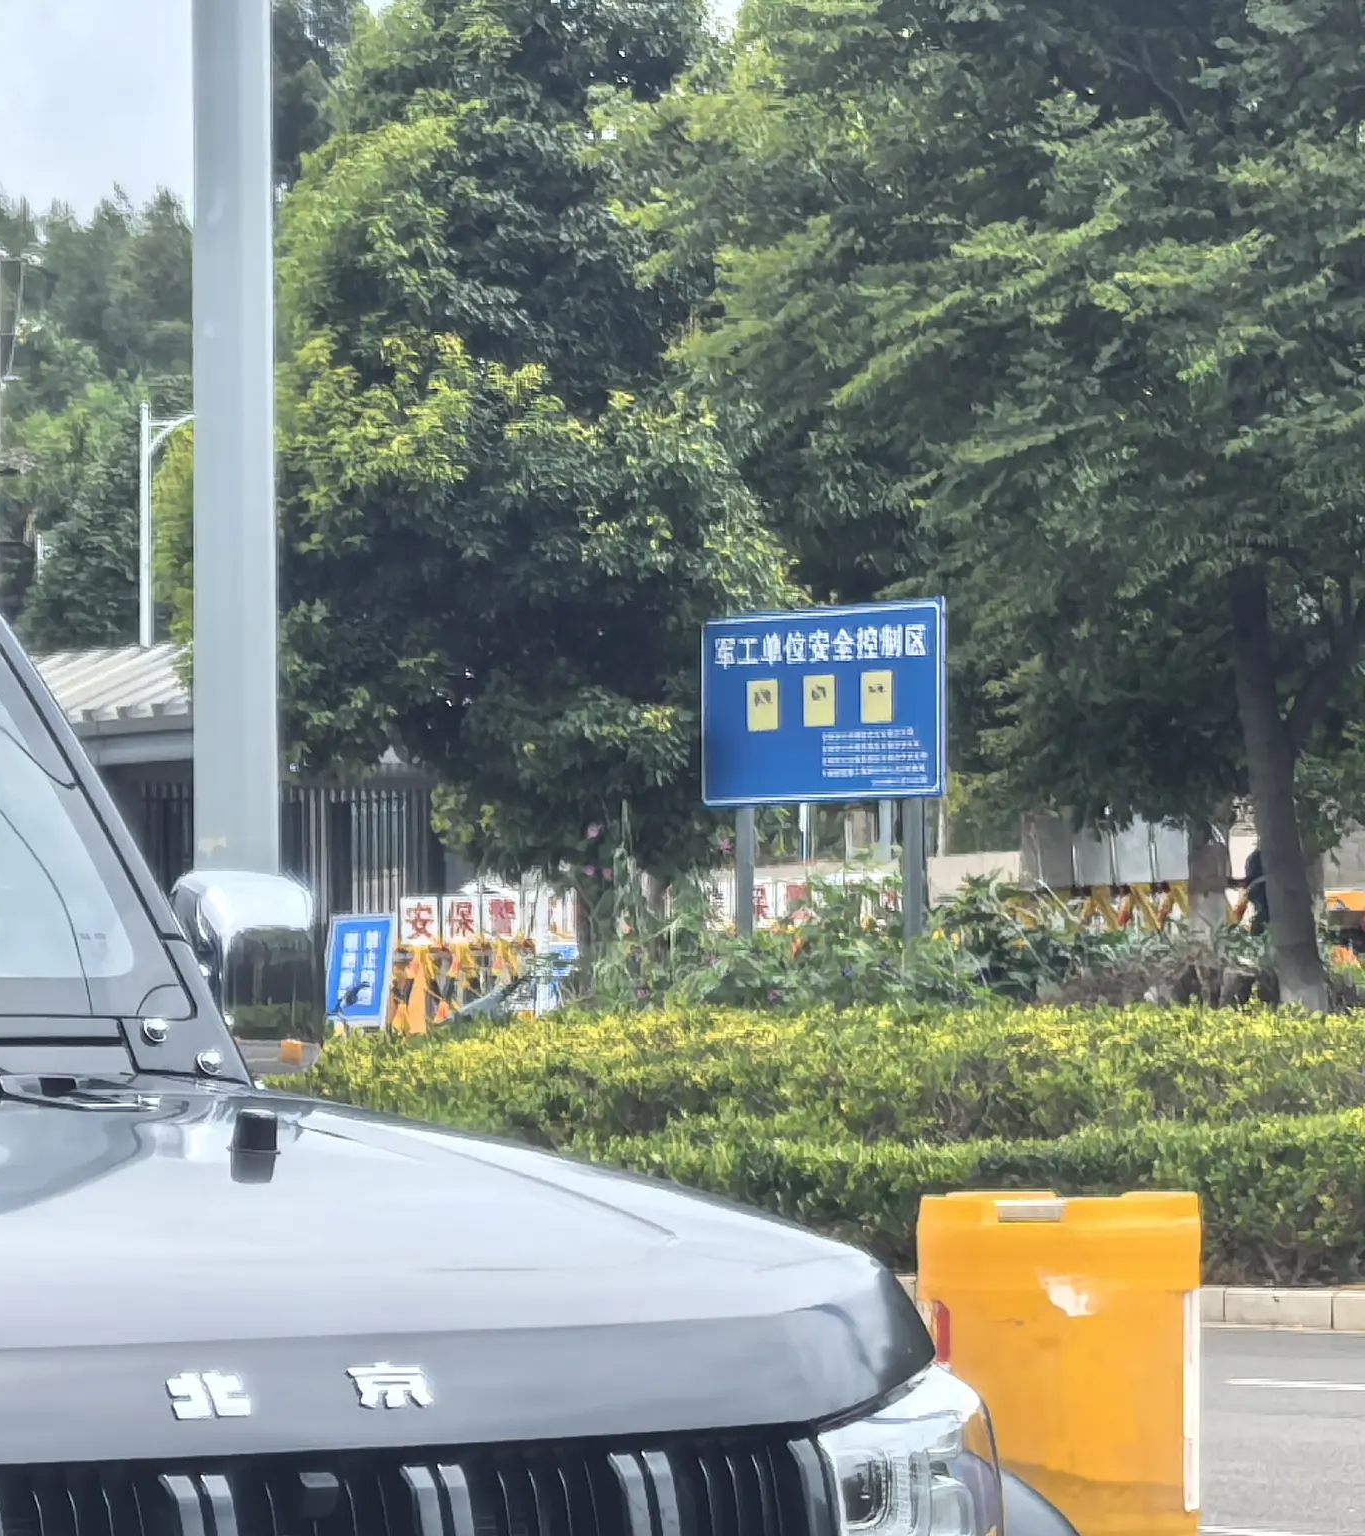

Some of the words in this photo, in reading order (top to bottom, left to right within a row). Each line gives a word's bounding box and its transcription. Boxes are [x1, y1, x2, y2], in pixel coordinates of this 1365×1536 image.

[714, 624, 926, 669] 军工单位安全控制区
